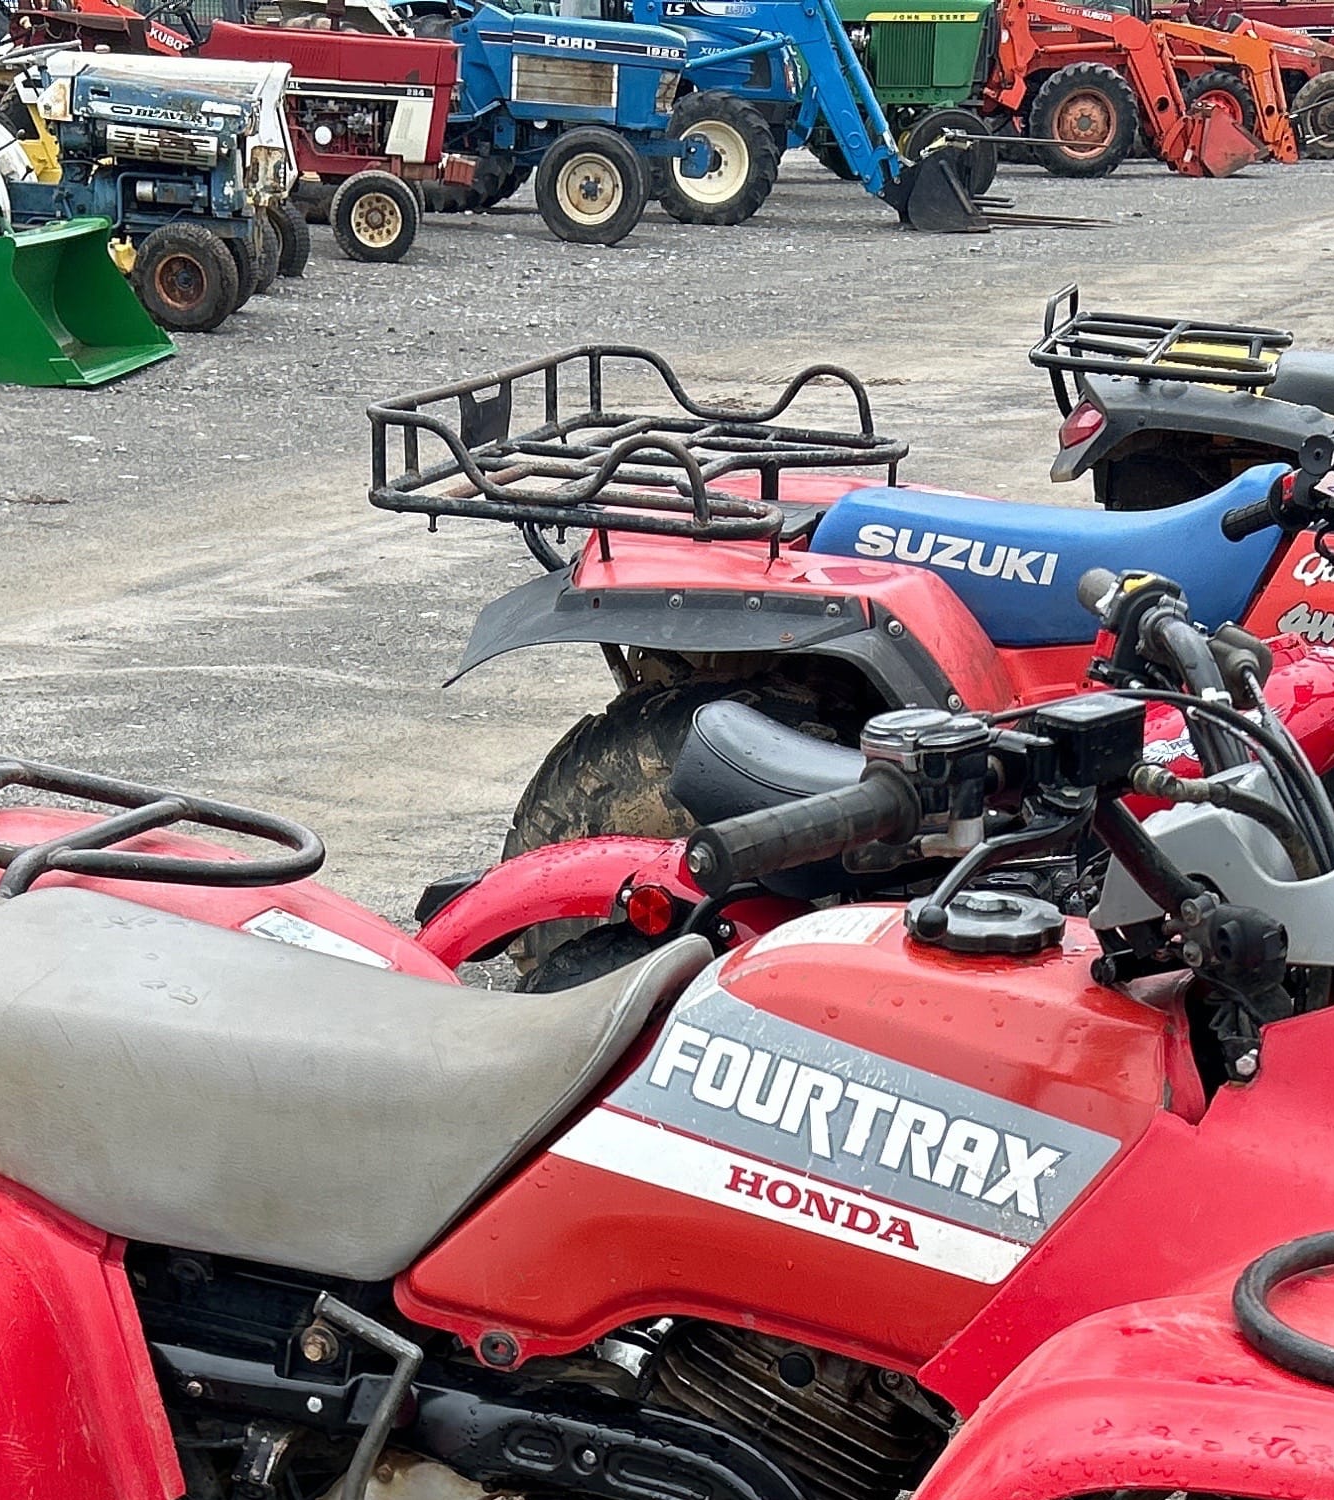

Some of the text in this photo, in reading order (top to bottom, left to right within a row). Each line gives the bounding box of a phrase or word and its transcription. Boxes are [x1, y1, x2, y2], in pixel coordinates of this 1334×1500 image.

[666, 4, 685, 16] LS
[1081, 10, 1113, 22] KUBOTA
[544, 36, 680, 58] FORD 1920
[854, 524, 1059, 585] SUZUKI
[647, 1020, 1068, 1223] FOURTRAX
[724, 1164, 919, 1251] HONDA
